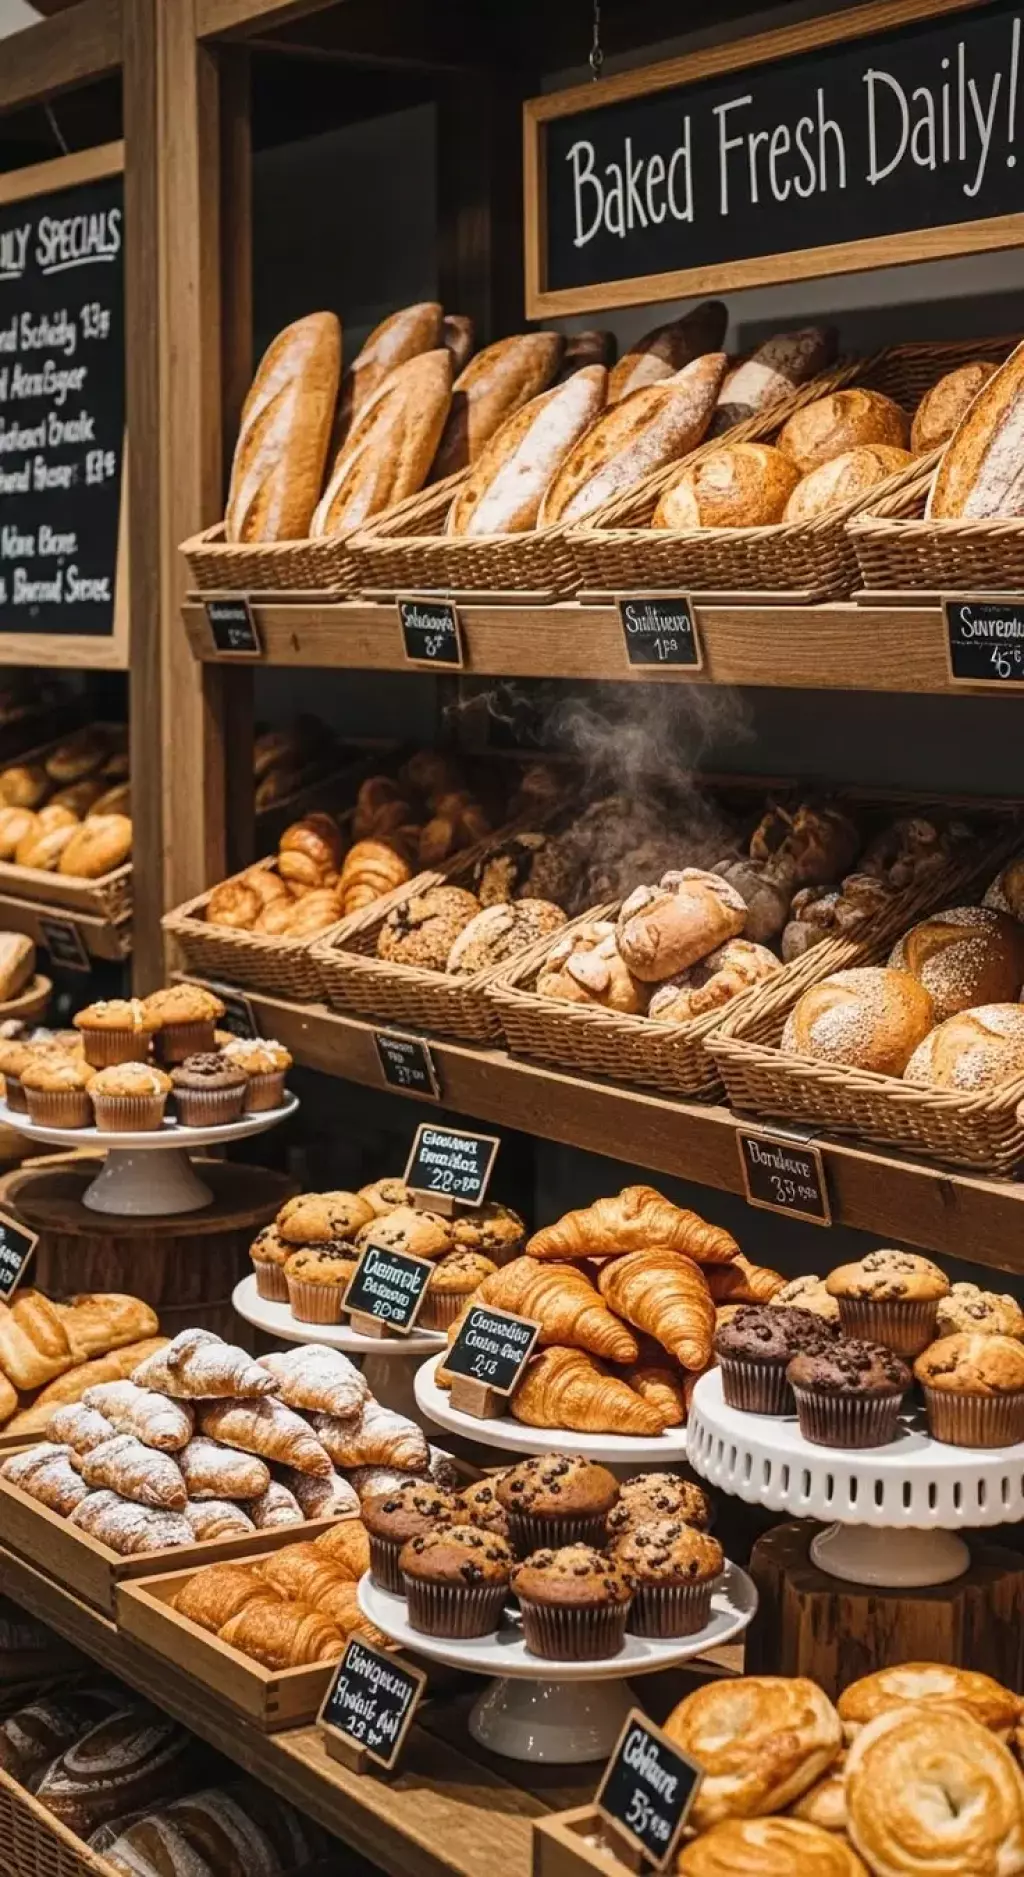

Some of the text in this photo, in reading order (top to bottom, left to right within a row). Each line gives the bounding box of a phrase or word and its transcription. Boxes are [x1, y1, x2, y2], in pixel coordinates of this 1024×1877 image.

[565, 18, 1021, 247] Baked Fresh Daily!
[35, 208, 121, 266] SPECIALS
